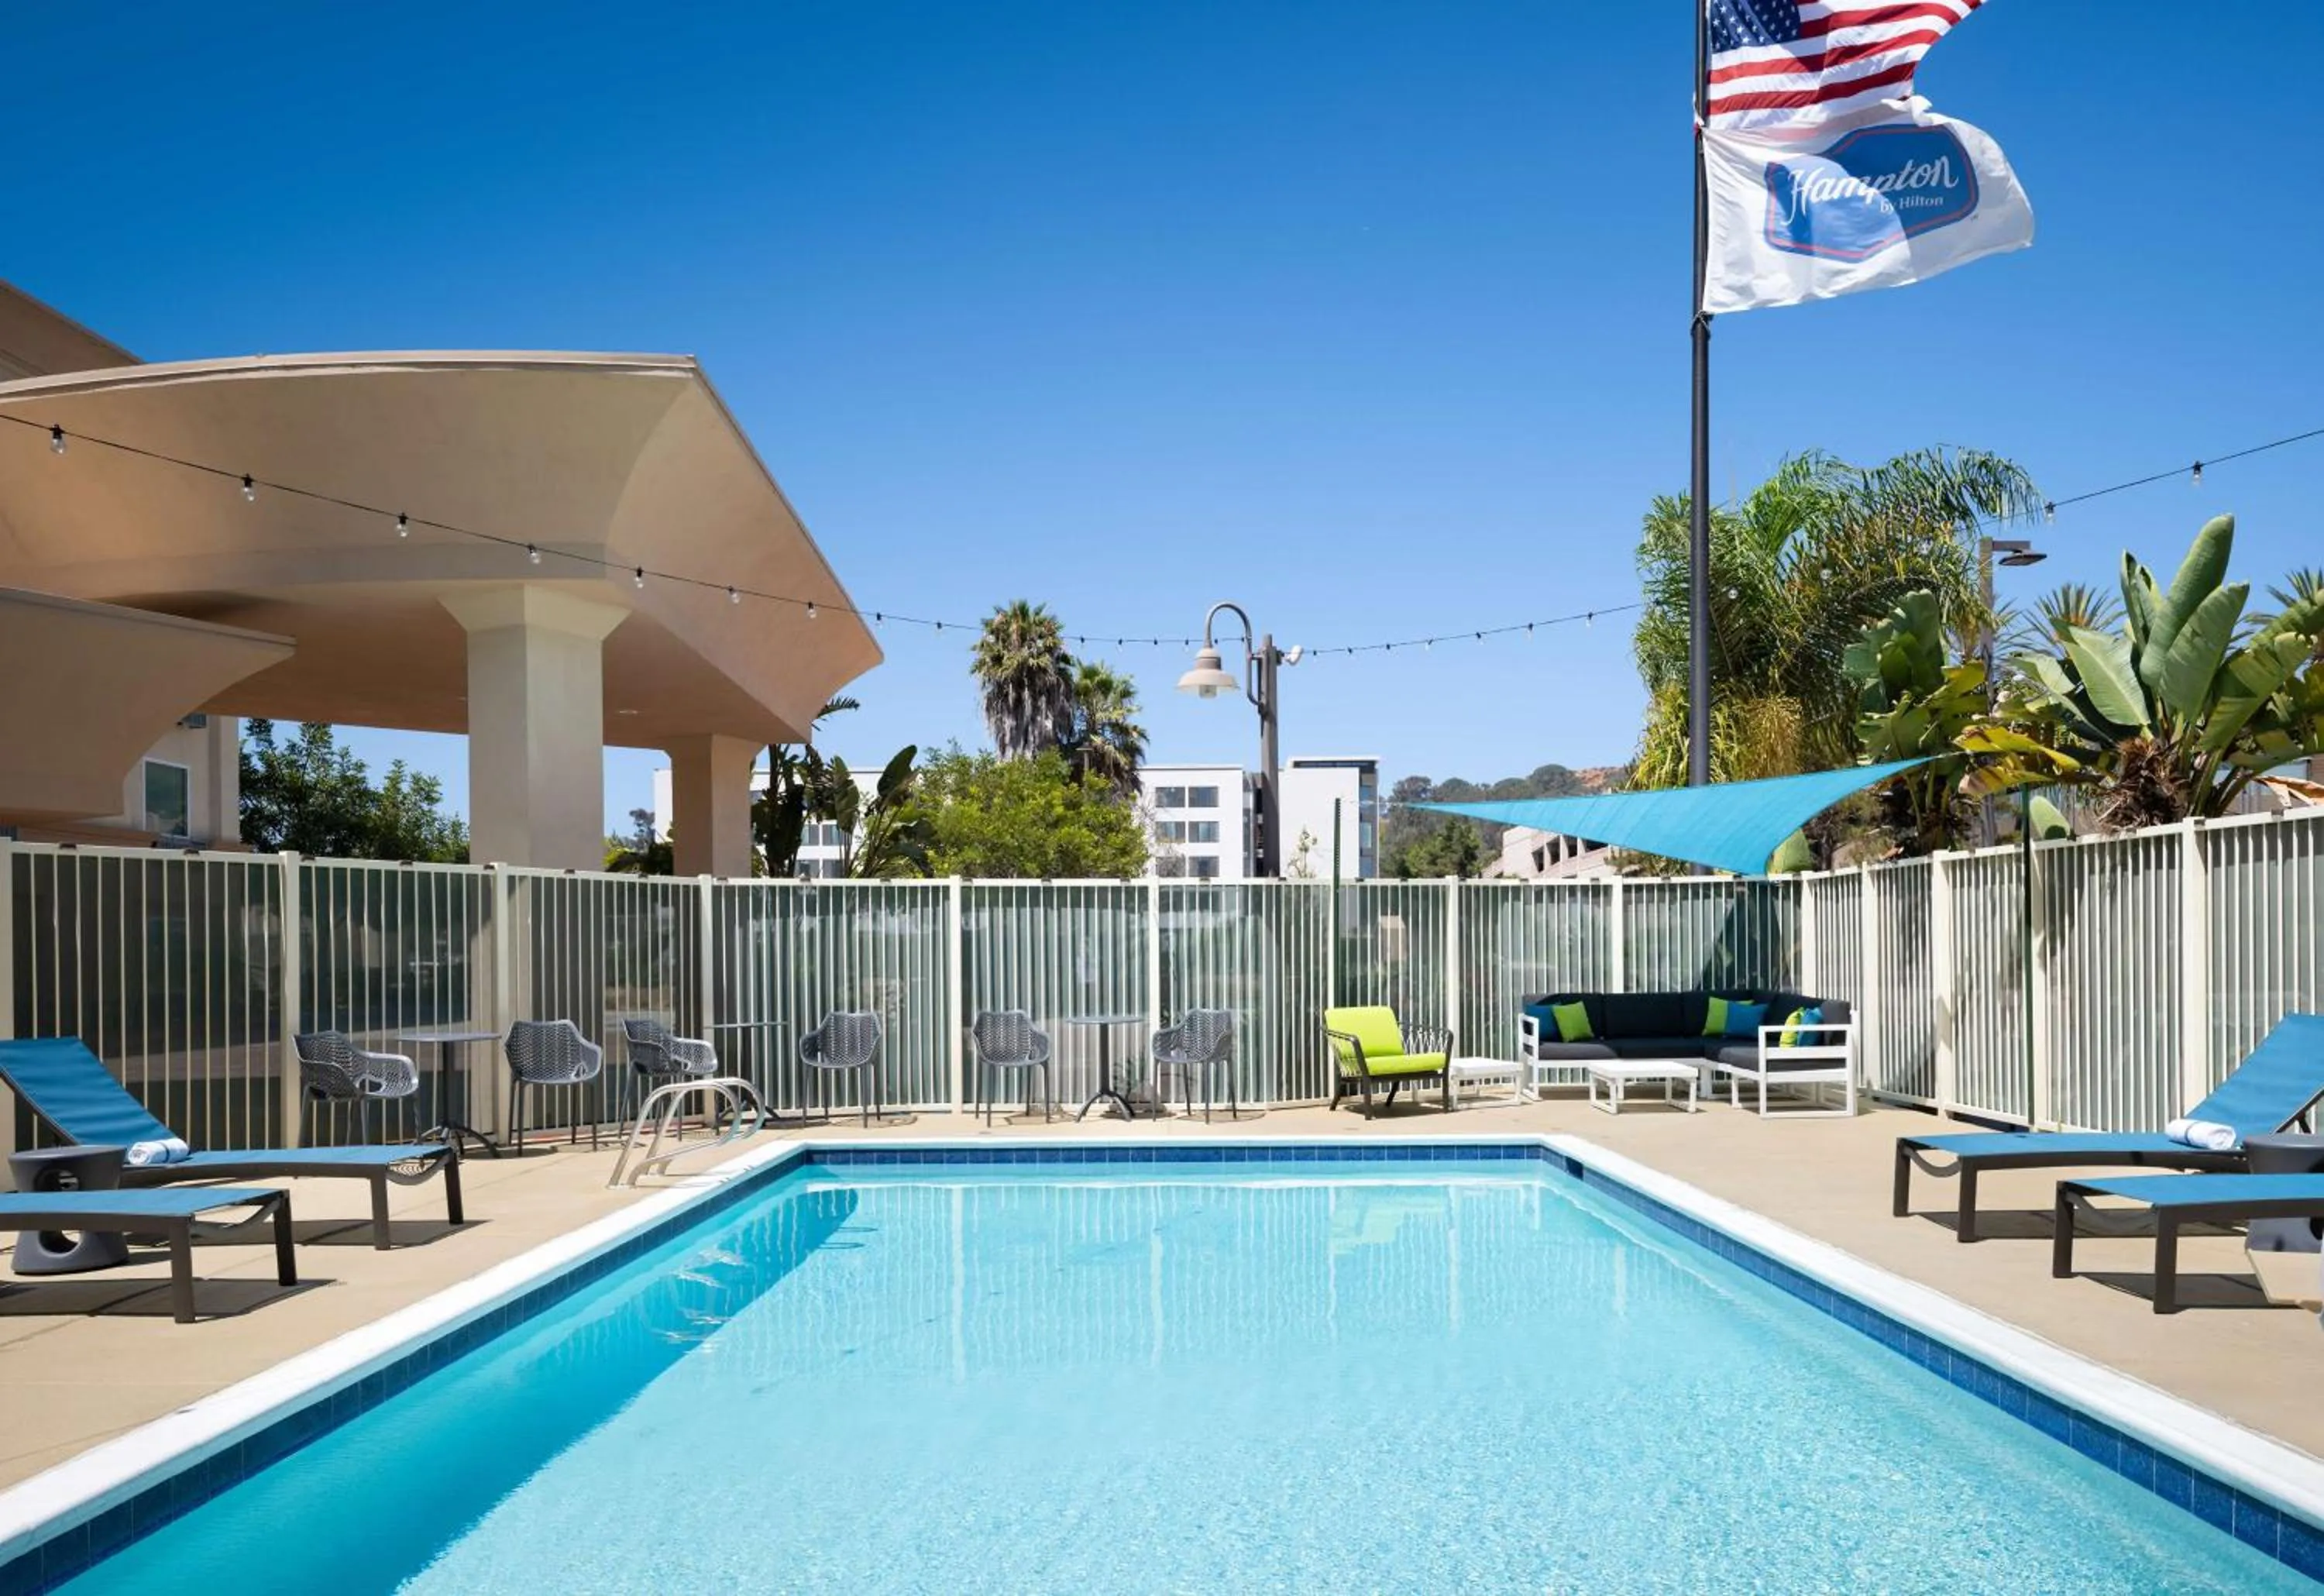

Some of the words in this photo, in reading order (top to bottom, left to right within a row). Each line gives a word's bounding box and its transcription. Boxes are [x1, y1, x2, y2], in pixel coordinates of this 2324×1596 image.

[1780, 155, 1959, 226] Hampton
[1879, 198, 1897, 215] by
[1899, 194, 1944, 210] Hilton
